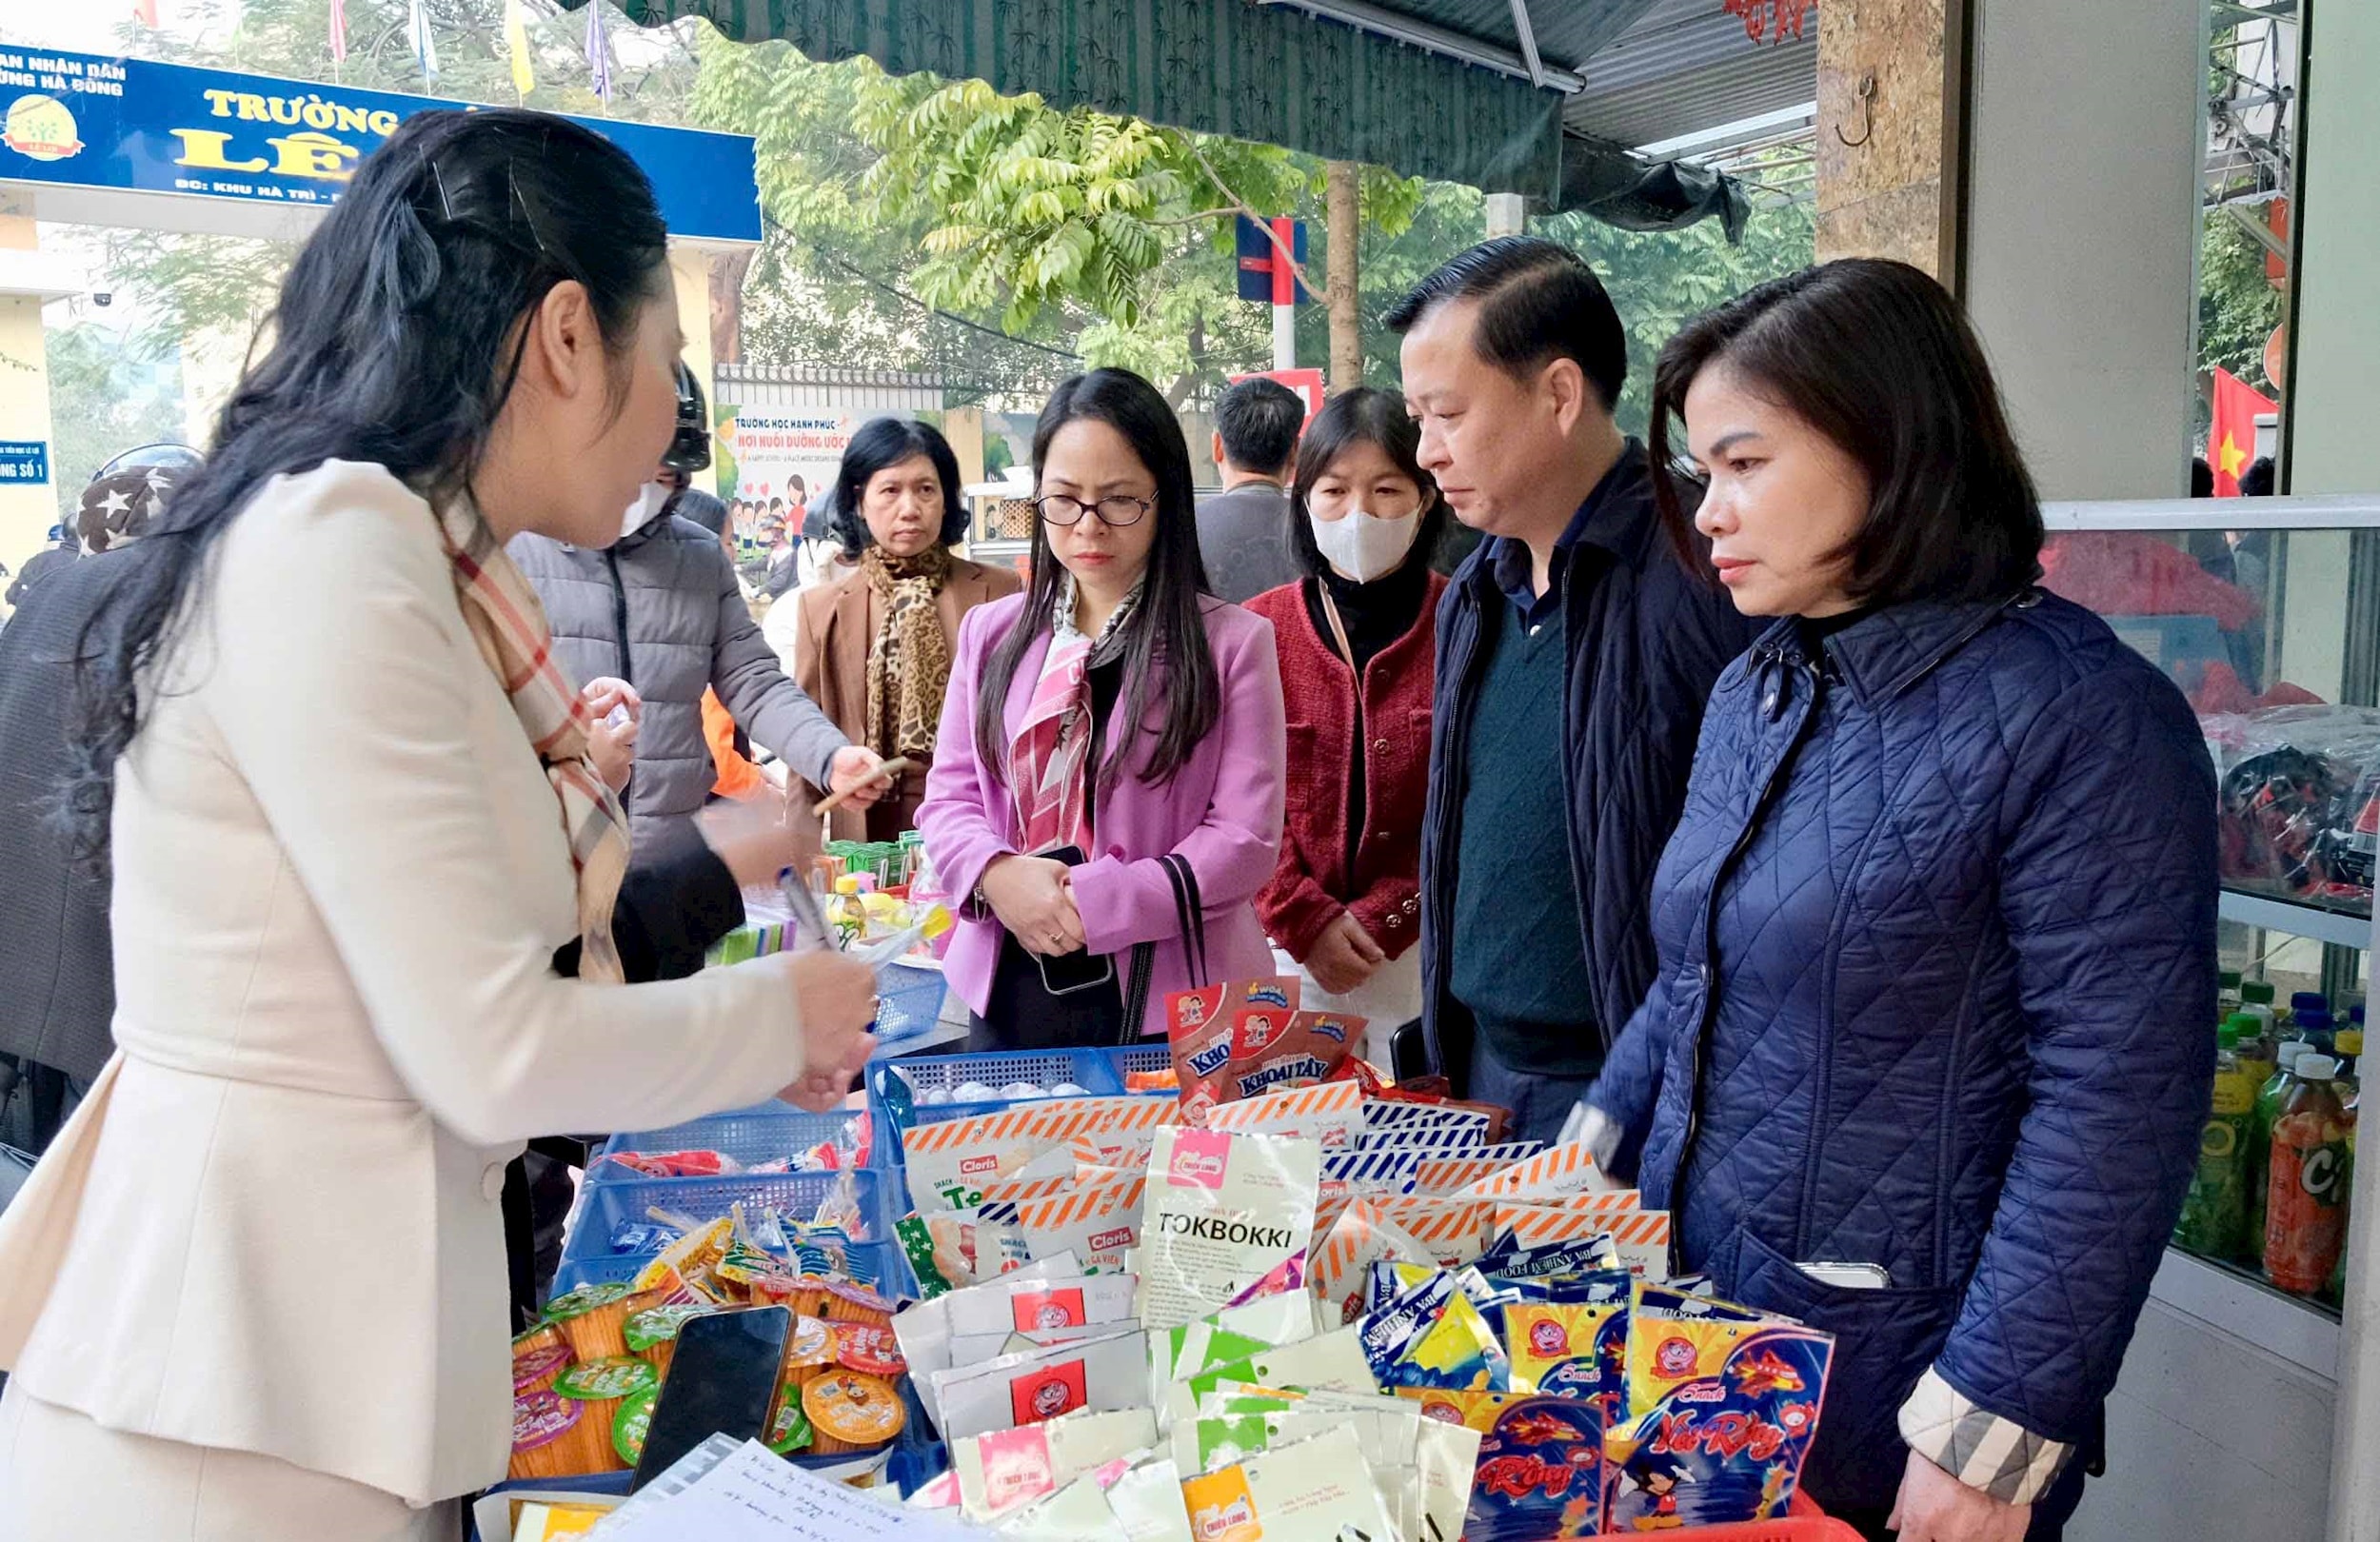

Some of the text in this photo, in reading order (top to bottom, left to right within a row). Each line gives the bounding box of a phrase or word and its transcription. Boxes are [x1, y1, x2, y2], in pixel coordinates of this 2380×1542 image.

[28, 57, 83, 75] NHÂN
[87, 62, 126, 81] DÂN
[41, 73, 67, 89] HÀ
[71, 78, 123, 96] ĐÔNG
[204, 89, 399, 136] TRƯỜNG
[169, 128, 359, 182] LÊ
[213, 182, 252, 195] KHU
[258, 184, 284, 197] HÀ
[288, 188, 316, 201] TRÌ
[0, 458, 44, 478] NG SỐ 1
[1190, 1042, 1230, 1074] KHO
[1240, 1064, 1293, 1095] KHOAI
[1296, 1058, 1327, 1079] TÂY
[962, 1156, 997, 1173] Cloris
[1091, 1231, 1131, 1250] Cloris
[1160, 1213, 1292, 1248] TOKBOKKI
[1343, 1296, 1361, 1323] oris
[1558, 1364, 1601, 1382] Snack
[1678, 1383, 1727, 1402] Snack
